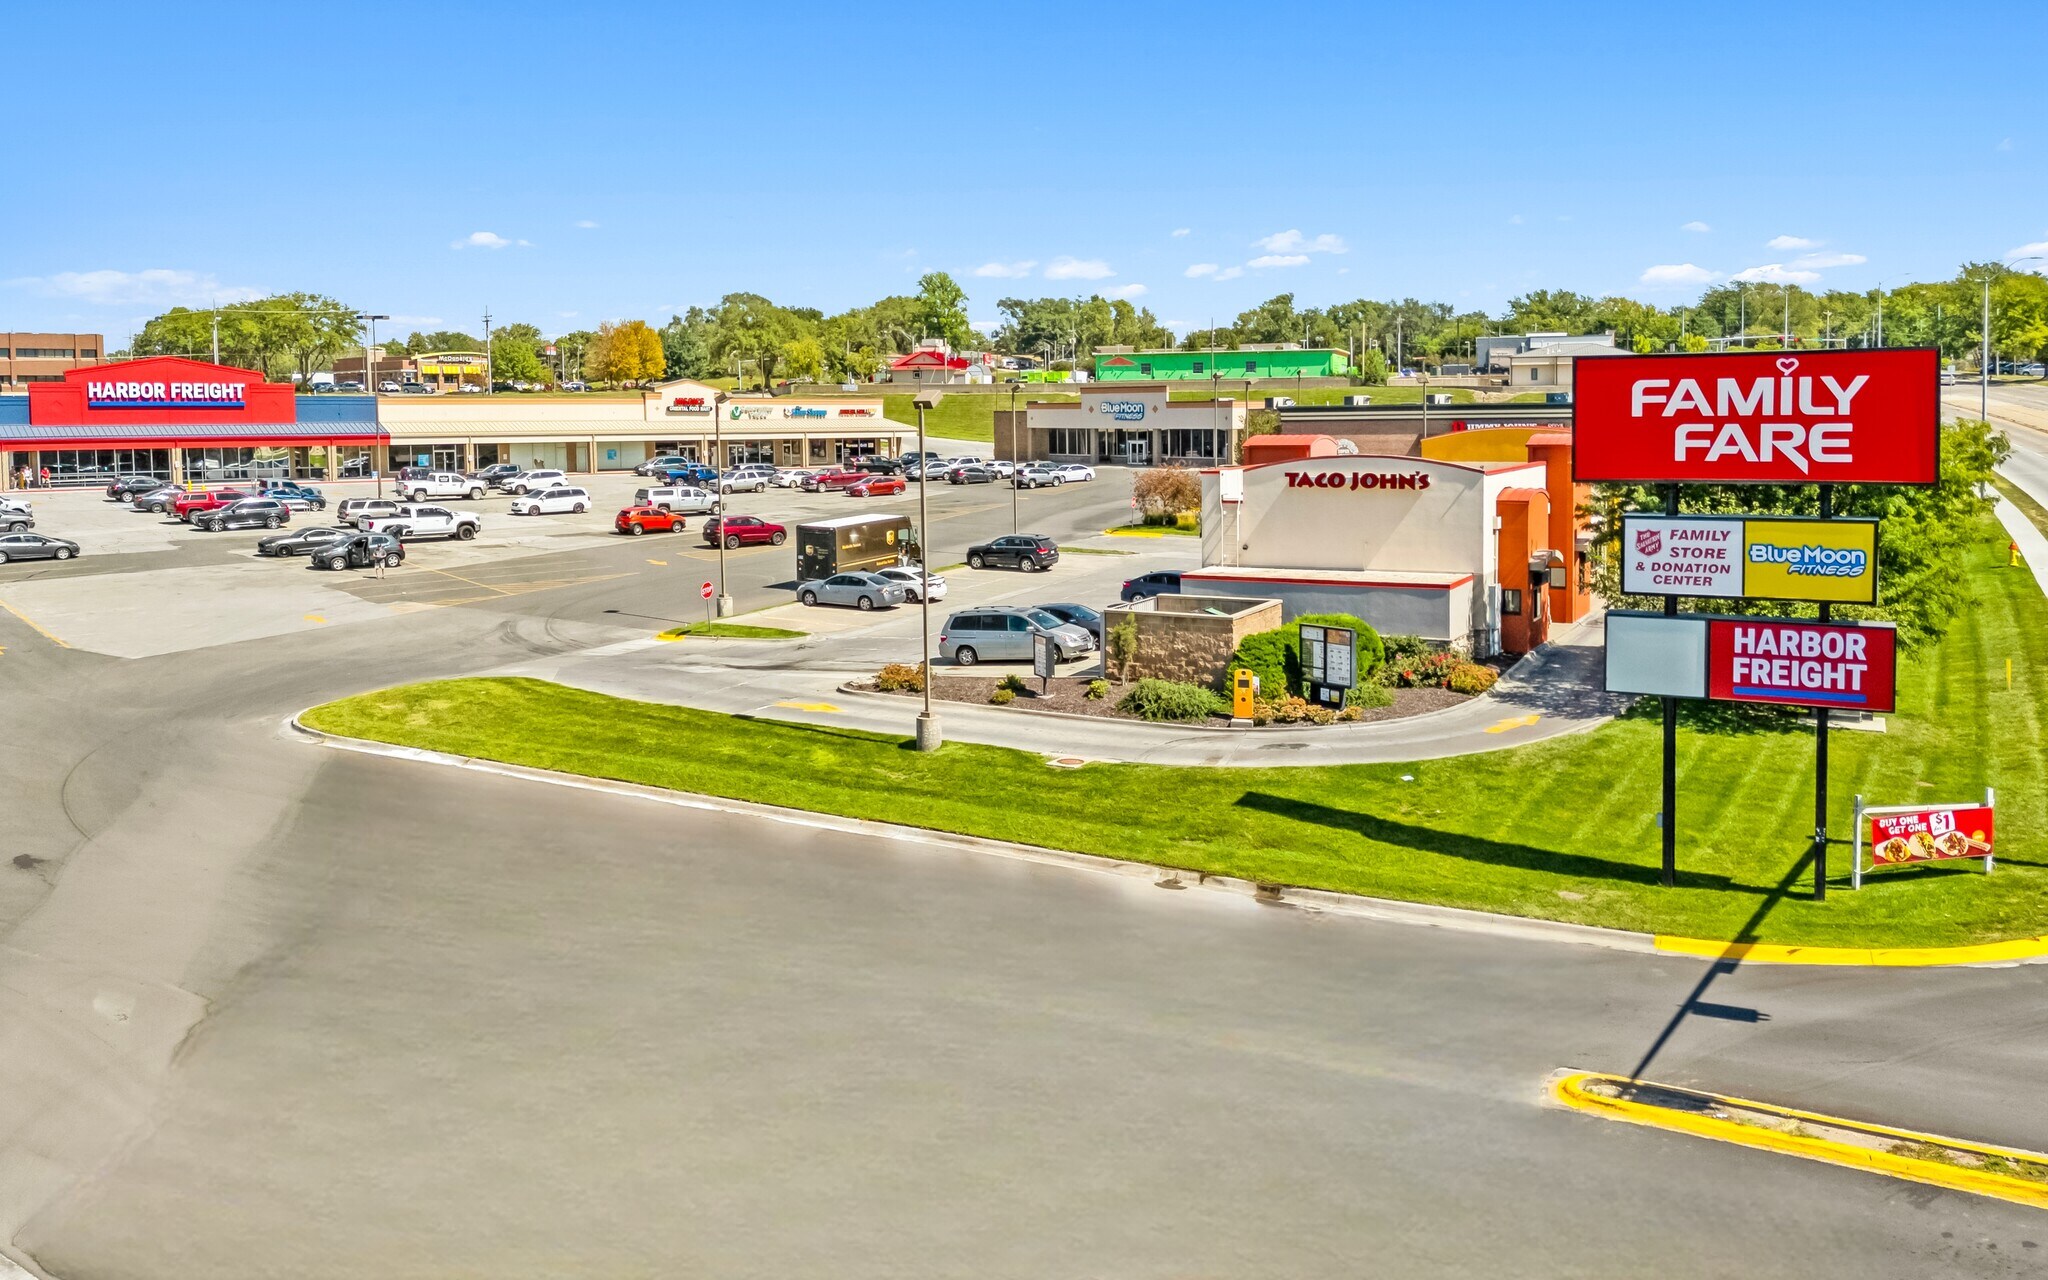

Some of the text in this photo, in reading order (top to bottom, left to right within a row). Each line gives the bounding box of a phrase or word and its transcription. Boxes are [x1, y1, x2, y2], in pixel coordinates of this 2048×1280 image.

[88, 382, 245, 399] HARBOR FREIGHT
[1631, 358, 1870, 417] FAMILY
[1101, 402, 1143, 413] Blue Moon
[1674, 422, 1853, 475] FARE
[1285, 471, 1430, 491] TACO JOHN'S
[1669, 529, 1731, 541] FAMILY
[1644, 542, 1660, 554] ARMY
[1669, 547, 1727, 559] STORE
[1750, 545, 1865, 564] Blue Moon
[1635, 562, 1731, 574] & DONATION
[1788, 564, 1865, 576] FITNESS
[1653, 575, 1713, 586] CENTER
[1734, 627, 1867, 661] HARBOR
[1732, 657, 1868, 691] FREIGHT
[1879, 815, 1919, 828] BUY ONE
[1935, 814, 1950, 830] $1
[1888, 822, 1928, 835] GET ONE
